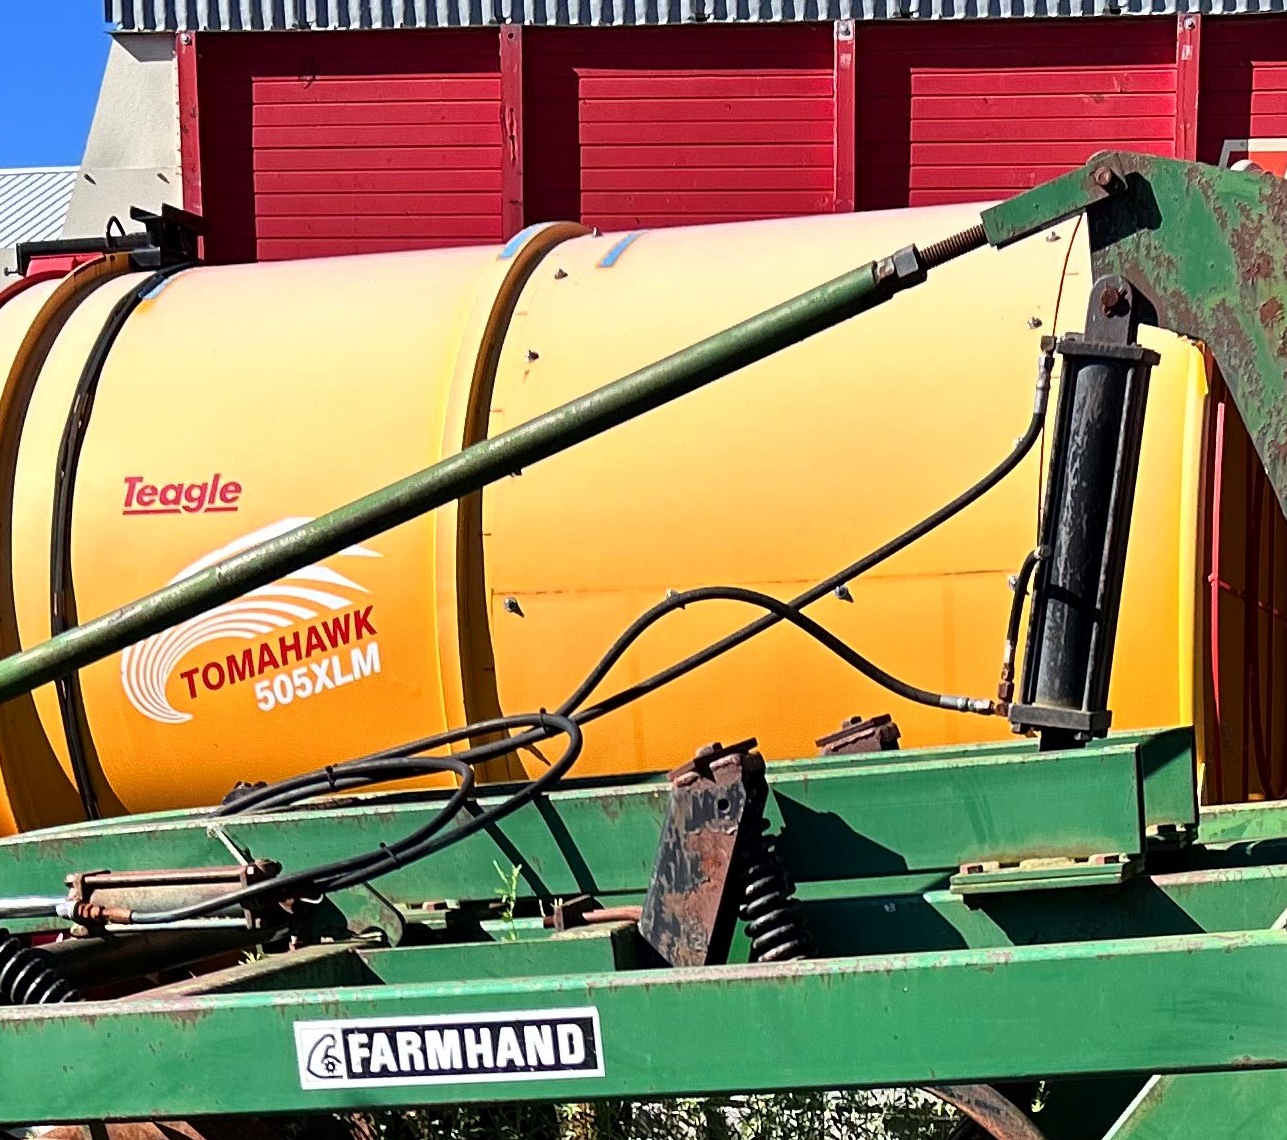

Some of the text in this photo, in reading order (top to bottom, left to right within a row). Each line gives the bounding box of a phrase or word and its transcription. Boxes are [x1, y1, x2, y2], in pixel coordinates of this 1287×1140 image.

[123, 473, 242, 514] Teagle
[180, 605, 378, 700] TOMAHAWK
[254, 641, 382, 712] 505XLM
[346, 1022, 586, 1074] FARMHAND
